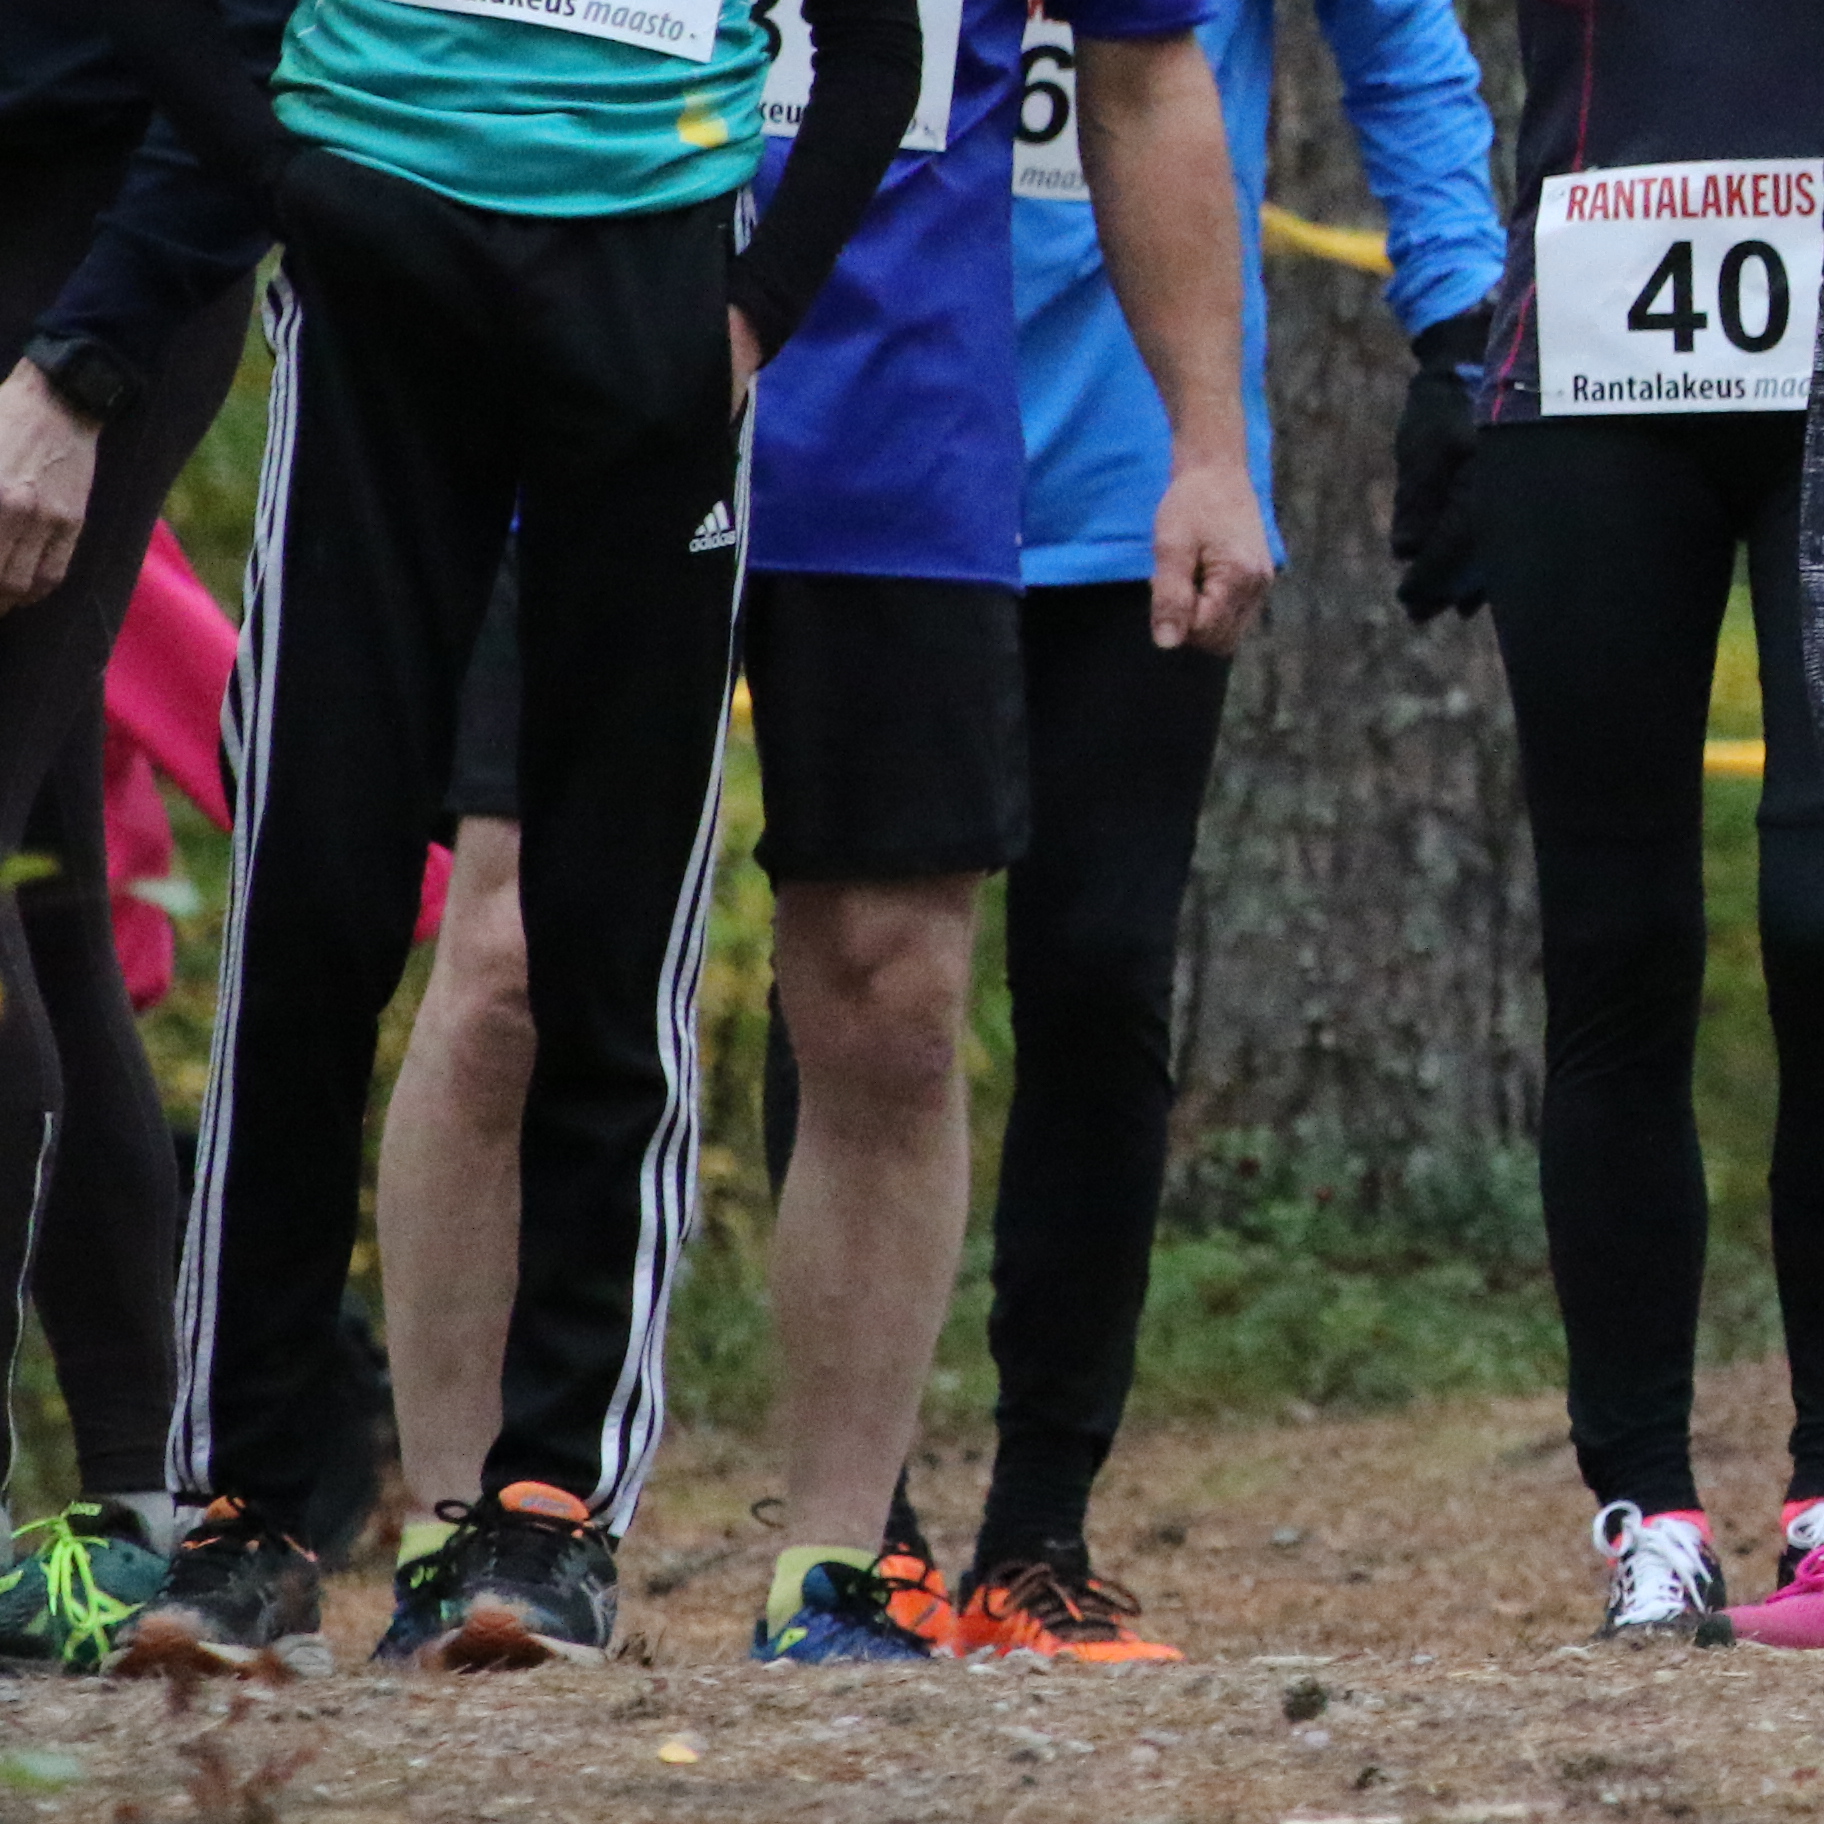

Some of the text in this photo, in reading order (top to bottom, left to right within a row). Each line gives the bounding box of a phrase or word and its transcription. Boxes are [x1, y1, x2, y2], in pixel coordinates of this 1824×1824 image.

[1566, 172, 1816, 221] RANTALAKEUS
[1627, 238, 1790, 353] 40
[1573, 371, 1746, 402] Rantalakeus
